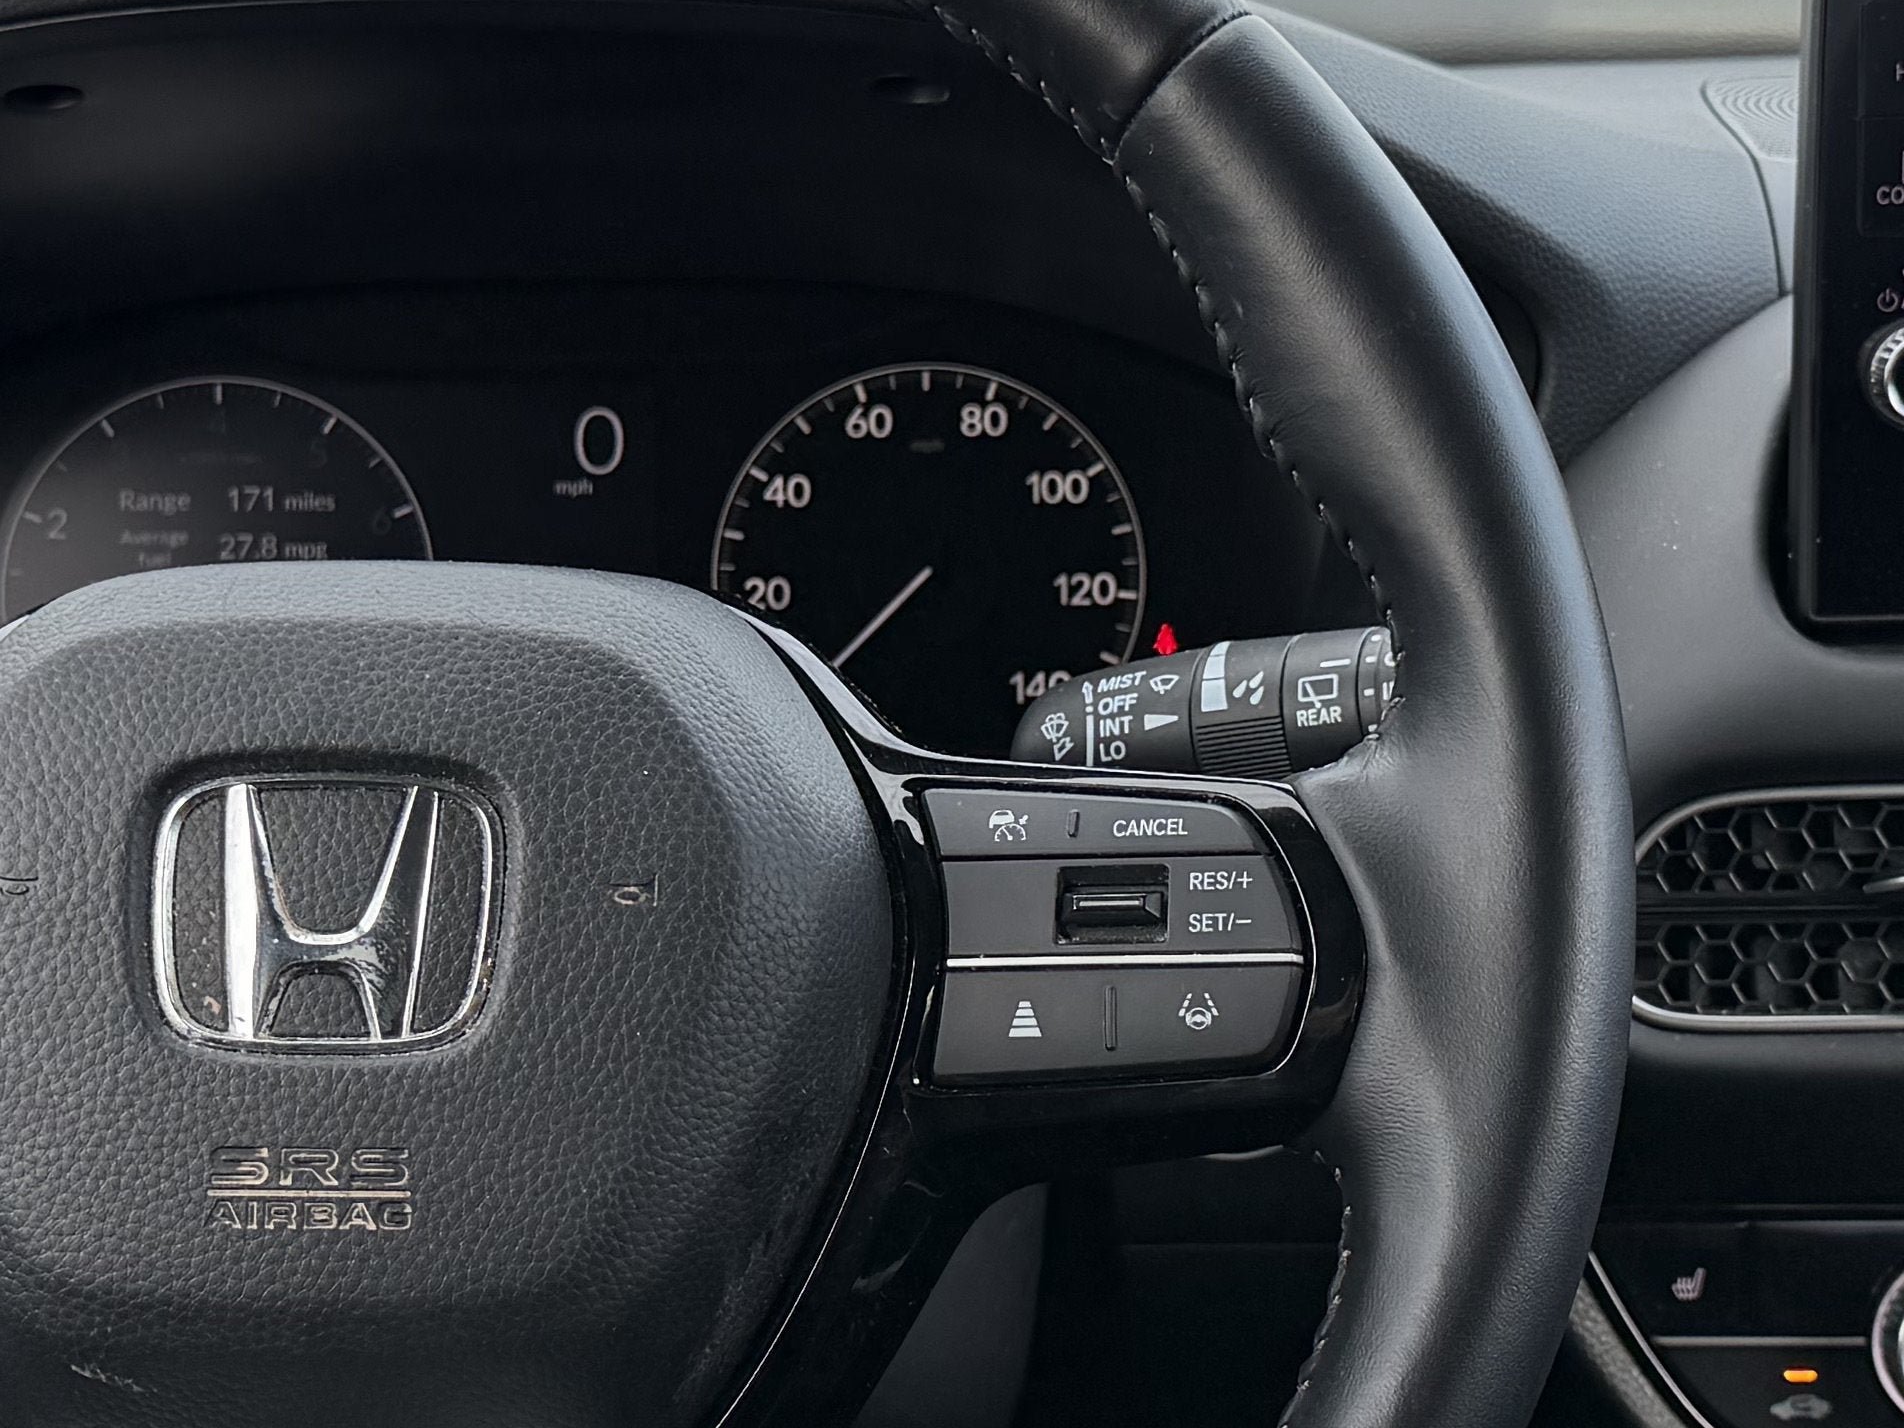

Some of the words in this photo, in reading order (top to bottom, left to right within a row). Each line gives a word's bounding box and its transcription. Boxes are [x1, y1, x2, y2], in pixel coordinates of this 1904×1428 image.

[843, 404, 894, 440] 60
[958, 402, 1010, 439] 80
[573, 405, 626, 476] 0
[118, 488, 192, 516] Range
[227, 484, 275, 513] 171
[283, 490, 337, 513] miles
[552, 478, 594, 499] mph
[762, 474, 813, 509] 40
[1026, 470, 1091, 506] 100
[45, 508, 69, 541] 2
[118, 529, 190, 549] Average
[219, 532, 278, 560] 27.8
[283, 540, 329, 561] mpg
[742, 575, 793, 612] 20
[1053, 572, 1119, 608] 120
[1097, 670, 1148, 694] MIST
[1097, 692, 1139, 716] OFF
[1296, 704, 1343, 728] REAR
[1099, 715, 1134, 738] INT
[1099, 740, 1127, 763] LO
[1111, 817, 1189, 838] CANCEL
[207, 1146, 411, 1188] SRS
[206, 1200, 414, 1232] AIRBAG
